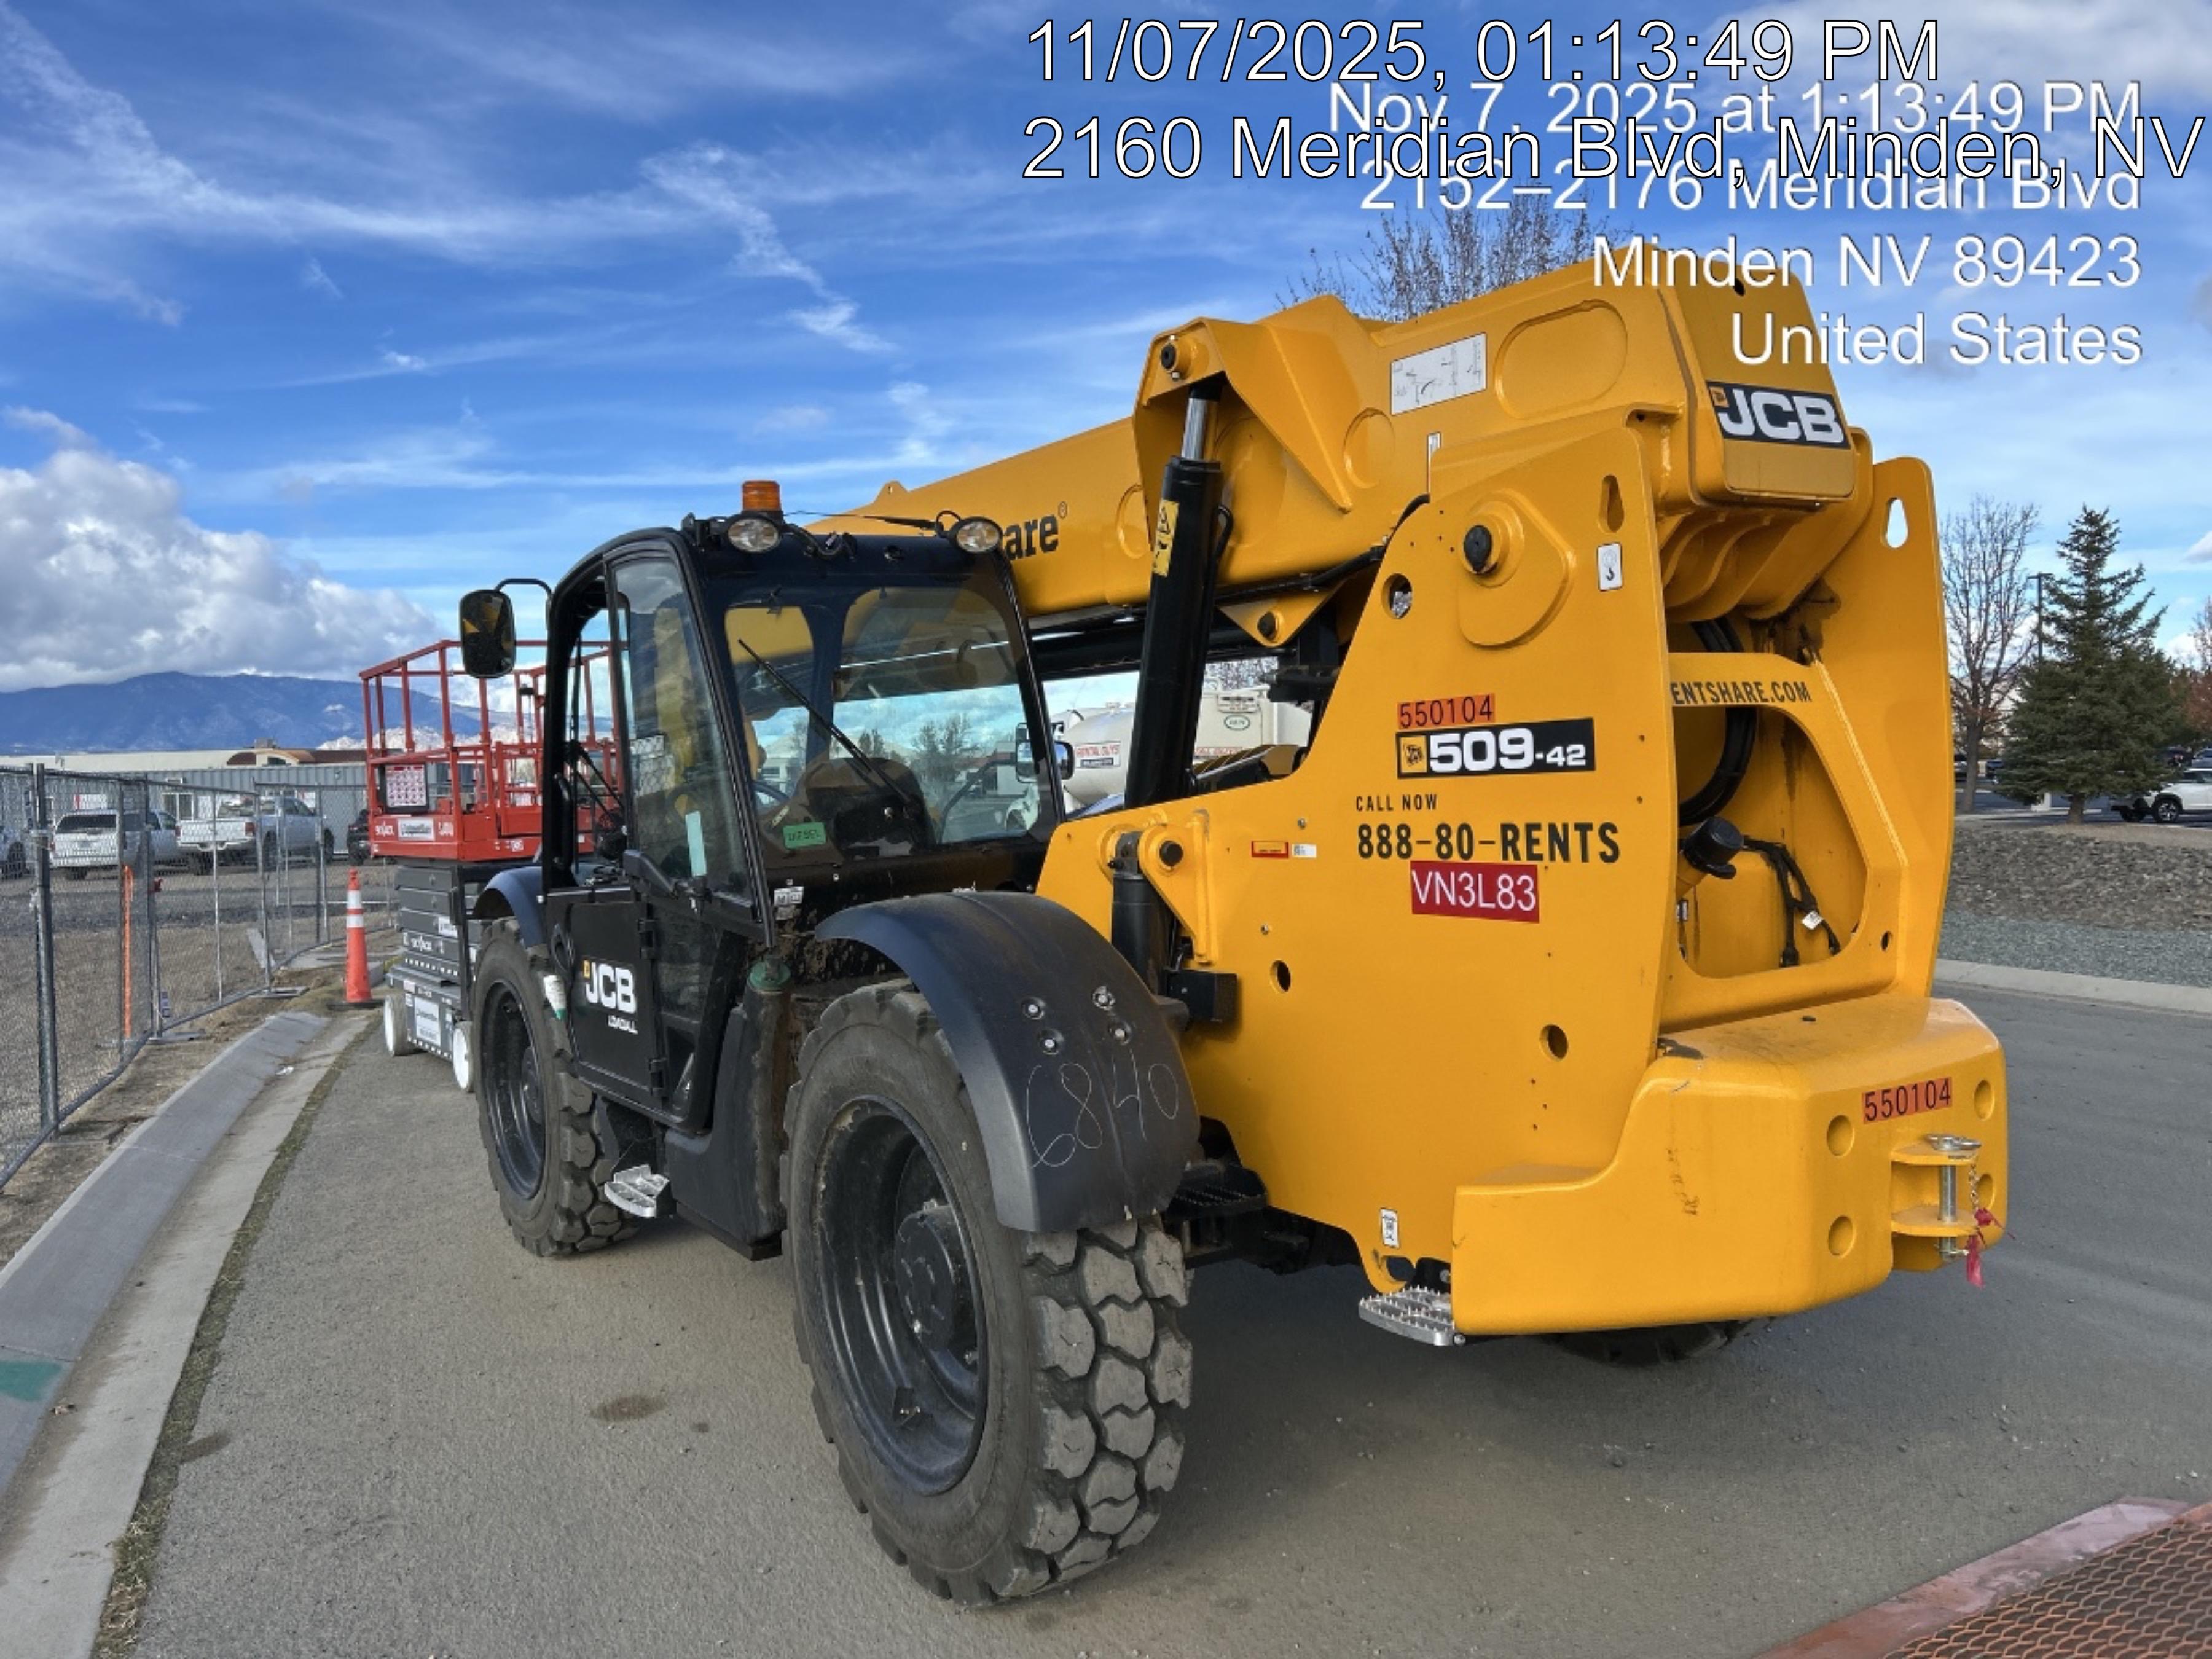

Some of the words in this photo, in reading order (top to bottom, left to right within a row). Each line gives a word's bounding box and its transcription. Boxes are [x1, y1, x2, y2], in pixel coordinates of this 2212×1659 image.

[1717, 388, 1844, 444] JCB
[1400, 694, 1493, 728] 550104
[1429, 728, 1586, 773] 509-42
[1355, 796, 1394, 812] CALL
[1402, 794, 1437, 810] NOW
[1357, 822, 1620, 864] 888-80-RENTS
[1411, 869, 1536, 912] VN3L83
[585, 960, 637, 1014] JCB
[1864, 1078, 1951, 1121] 550104
